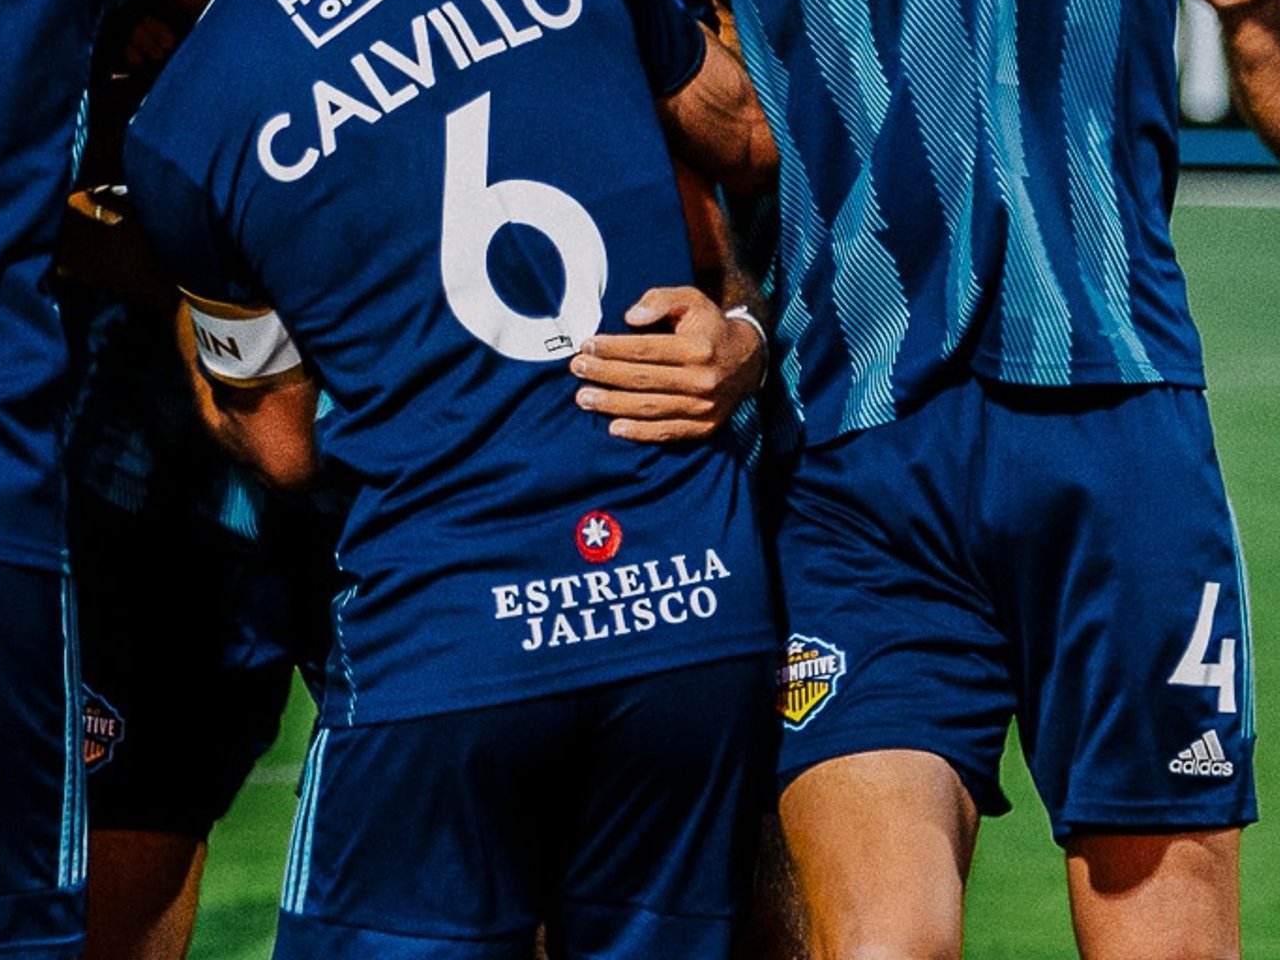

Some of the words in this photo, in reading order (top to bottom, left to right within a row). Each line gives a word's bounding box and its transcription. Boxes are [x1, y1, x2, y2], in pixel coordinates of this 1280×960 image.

[440, 90, 608, 362] 6
[199, 326, 244, 362] IN
[491, 547, 731, 620] ESTRELLA
[521, 585, 718, 652] JALISCO
[782, 654, 838, 683] MOTIVE
[1167, 580, 1237, 714] 4
[82, 715, 116, 737] TIVE
[1168, 757, 1234, 778] adidas
